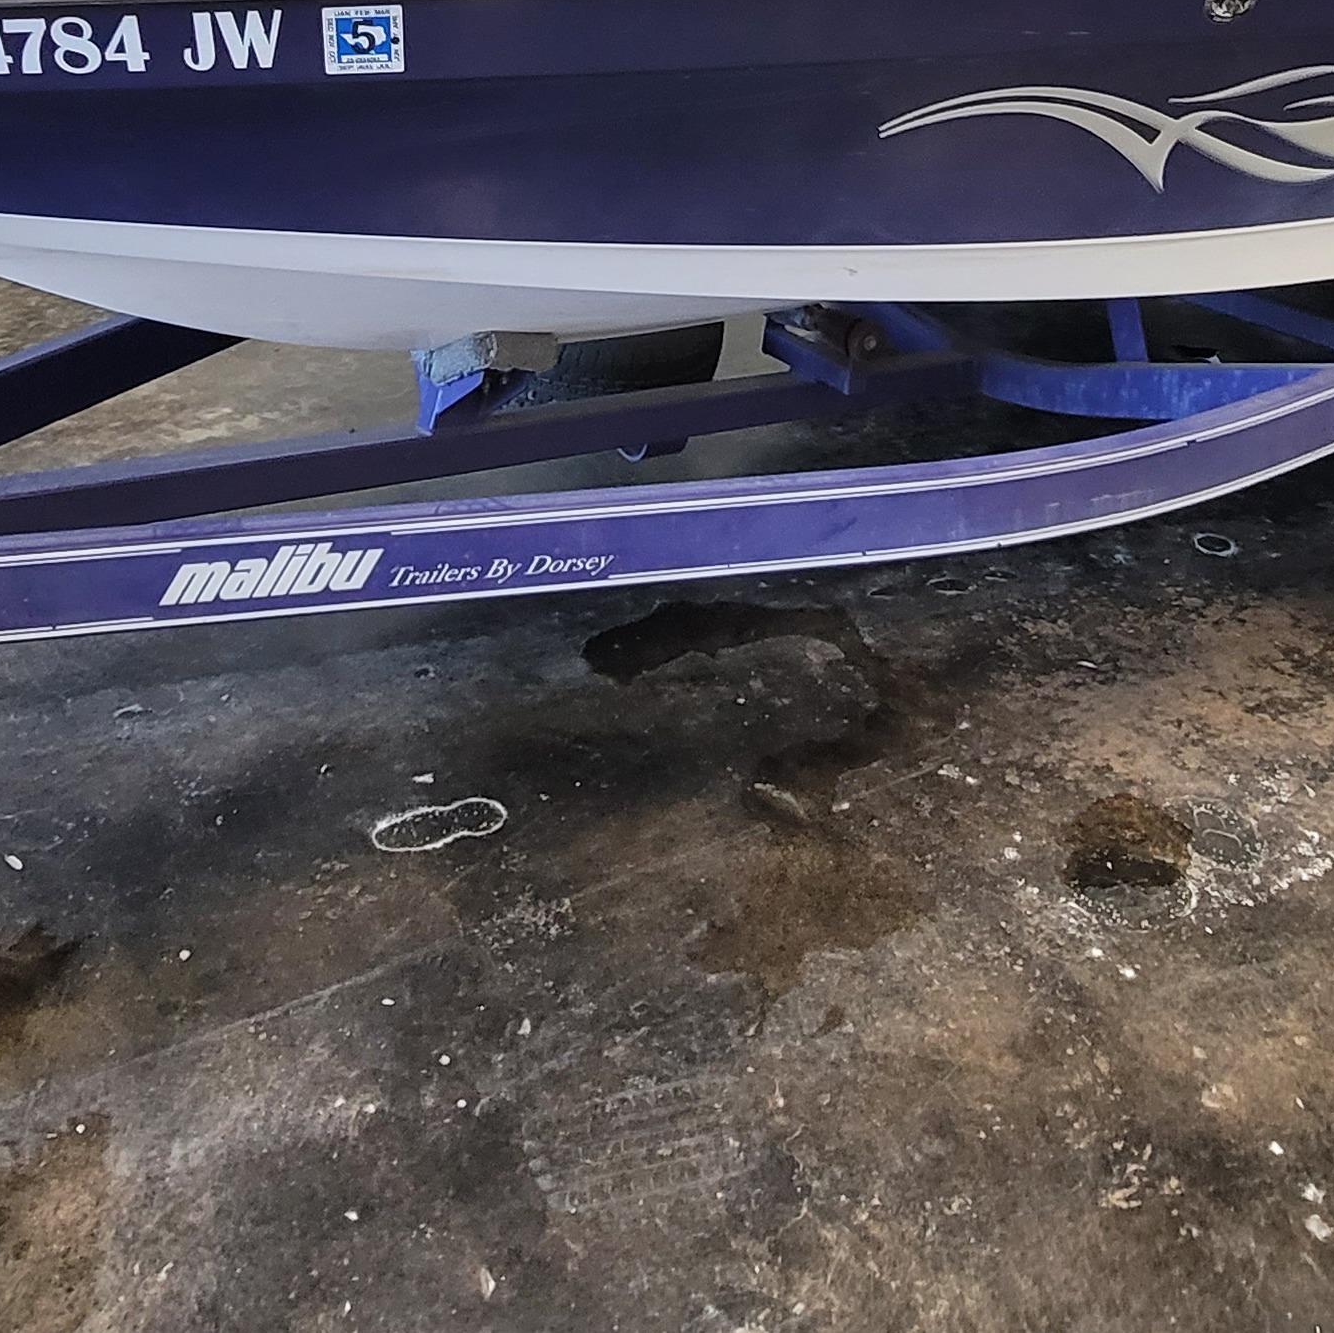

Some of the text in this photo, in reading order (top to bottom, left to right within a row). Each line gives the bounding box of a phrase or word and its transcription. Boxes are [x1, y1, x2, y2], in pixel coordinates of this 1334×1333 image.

[183, 9, 283, 73] JW
[352, 19, 376, 55] 5
[158, 542, 616, 607] malibu Trailers By Dorsey
